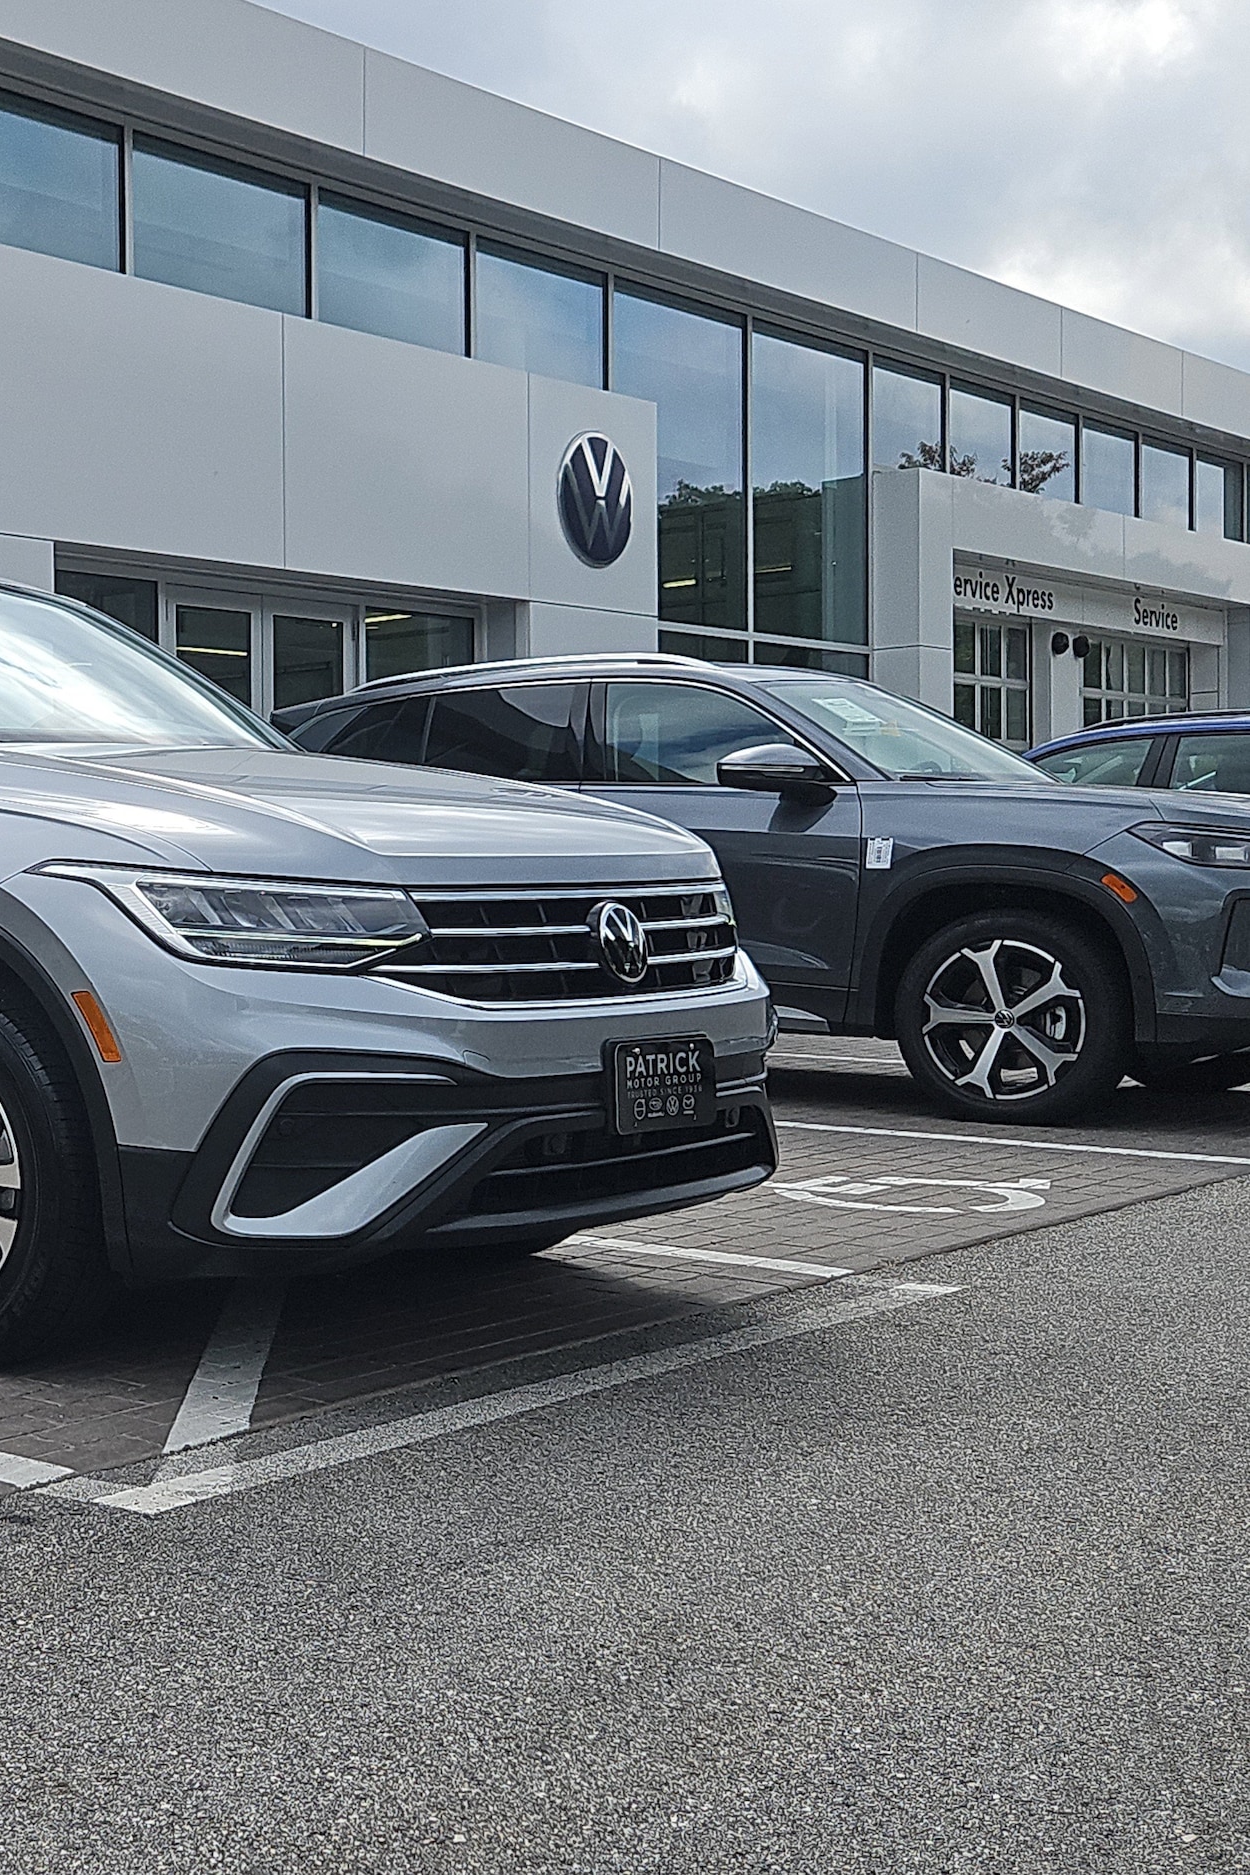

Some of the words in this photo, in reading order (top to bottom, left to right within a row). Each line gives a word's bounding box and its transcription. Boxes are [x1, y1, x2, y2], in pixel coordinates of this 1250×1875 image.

[953, 571, 1000, 602] ervice
[1004, 575, 1054, 612] Xpress
[1134, 597, 1178, 631] Service
[626, 1051, 701, 1078] PATRICK
[626, 1076, 660, 1089] MOTOR
[665, 1073, 701, 1085] GROUP
[627, 1089, 657, 1099] TRUSTED
[660, 1085, 682, 1095] SINCE
